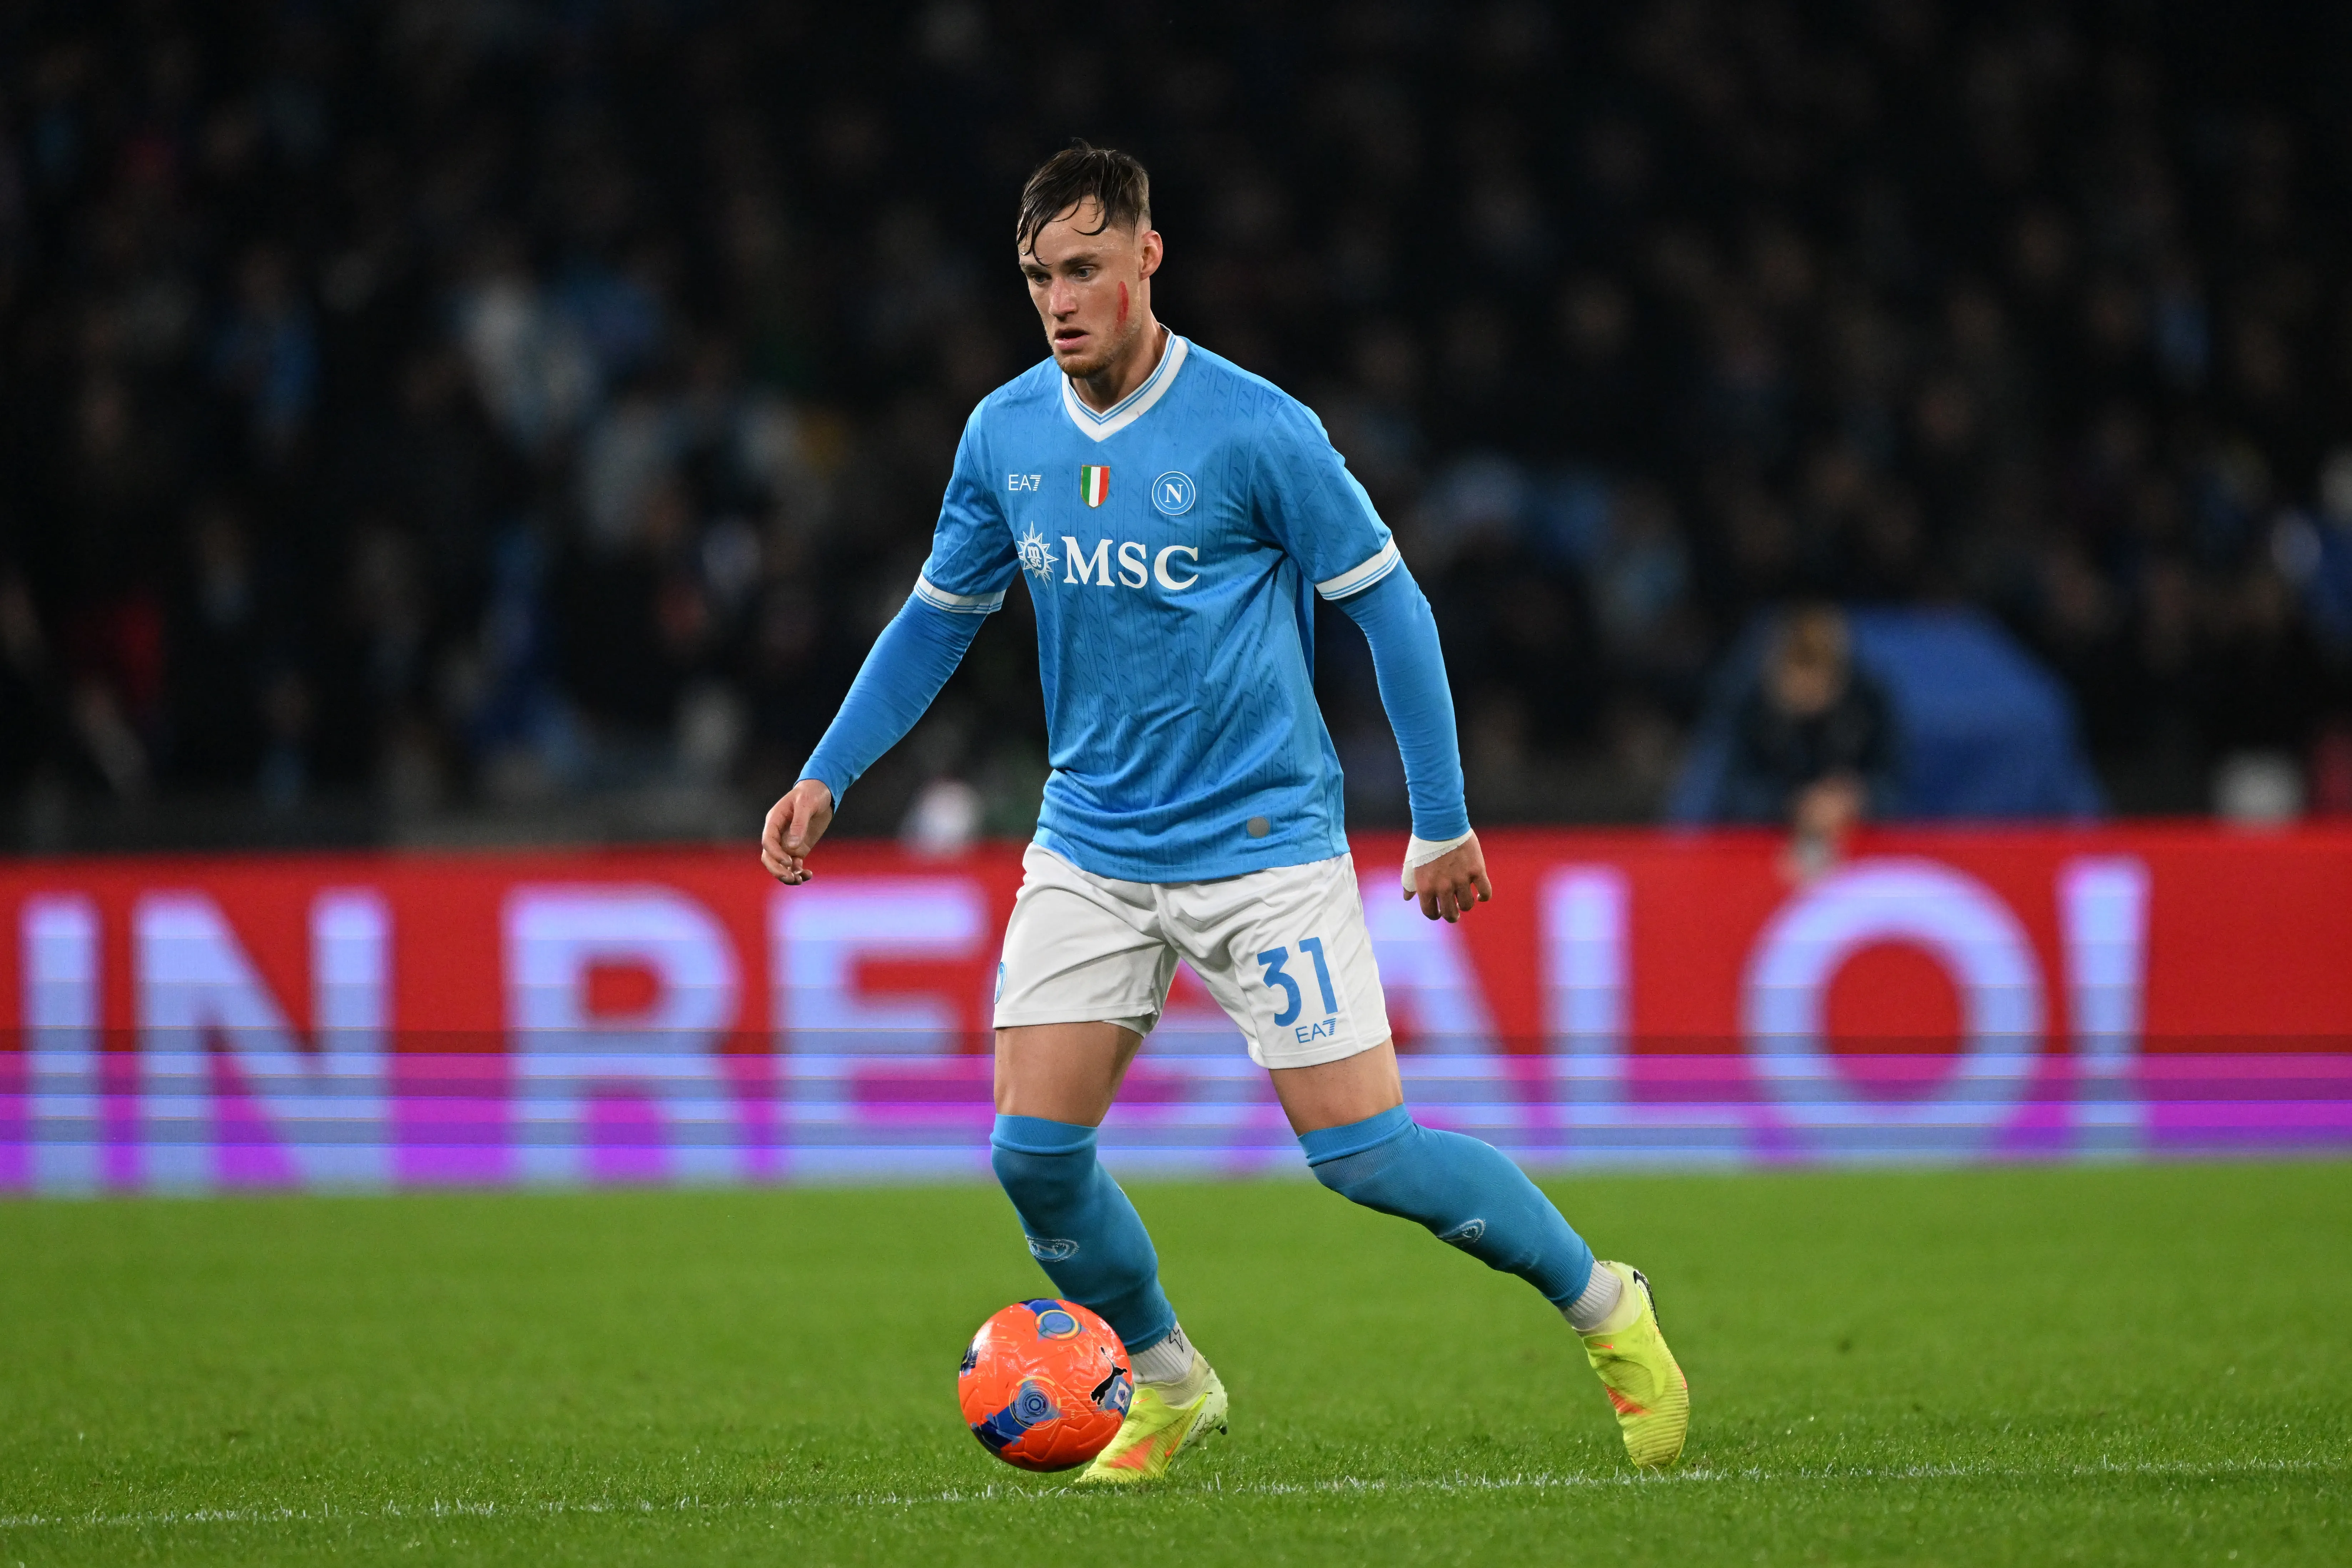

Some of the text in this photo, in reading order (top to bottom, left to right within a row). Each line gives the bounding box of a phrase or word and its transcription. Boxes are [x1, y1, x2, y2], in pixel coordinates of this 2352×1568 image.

[1009, 475, 1041, 491] EA7
[1165, 484, 1183, 503] N
[1061, 536, 1198, 590] MSC
[1257, 937, 1338, 1027] 31
[22, 888, 396, 1195] IN
[1295, 1018, 1336, 1044] EA7
